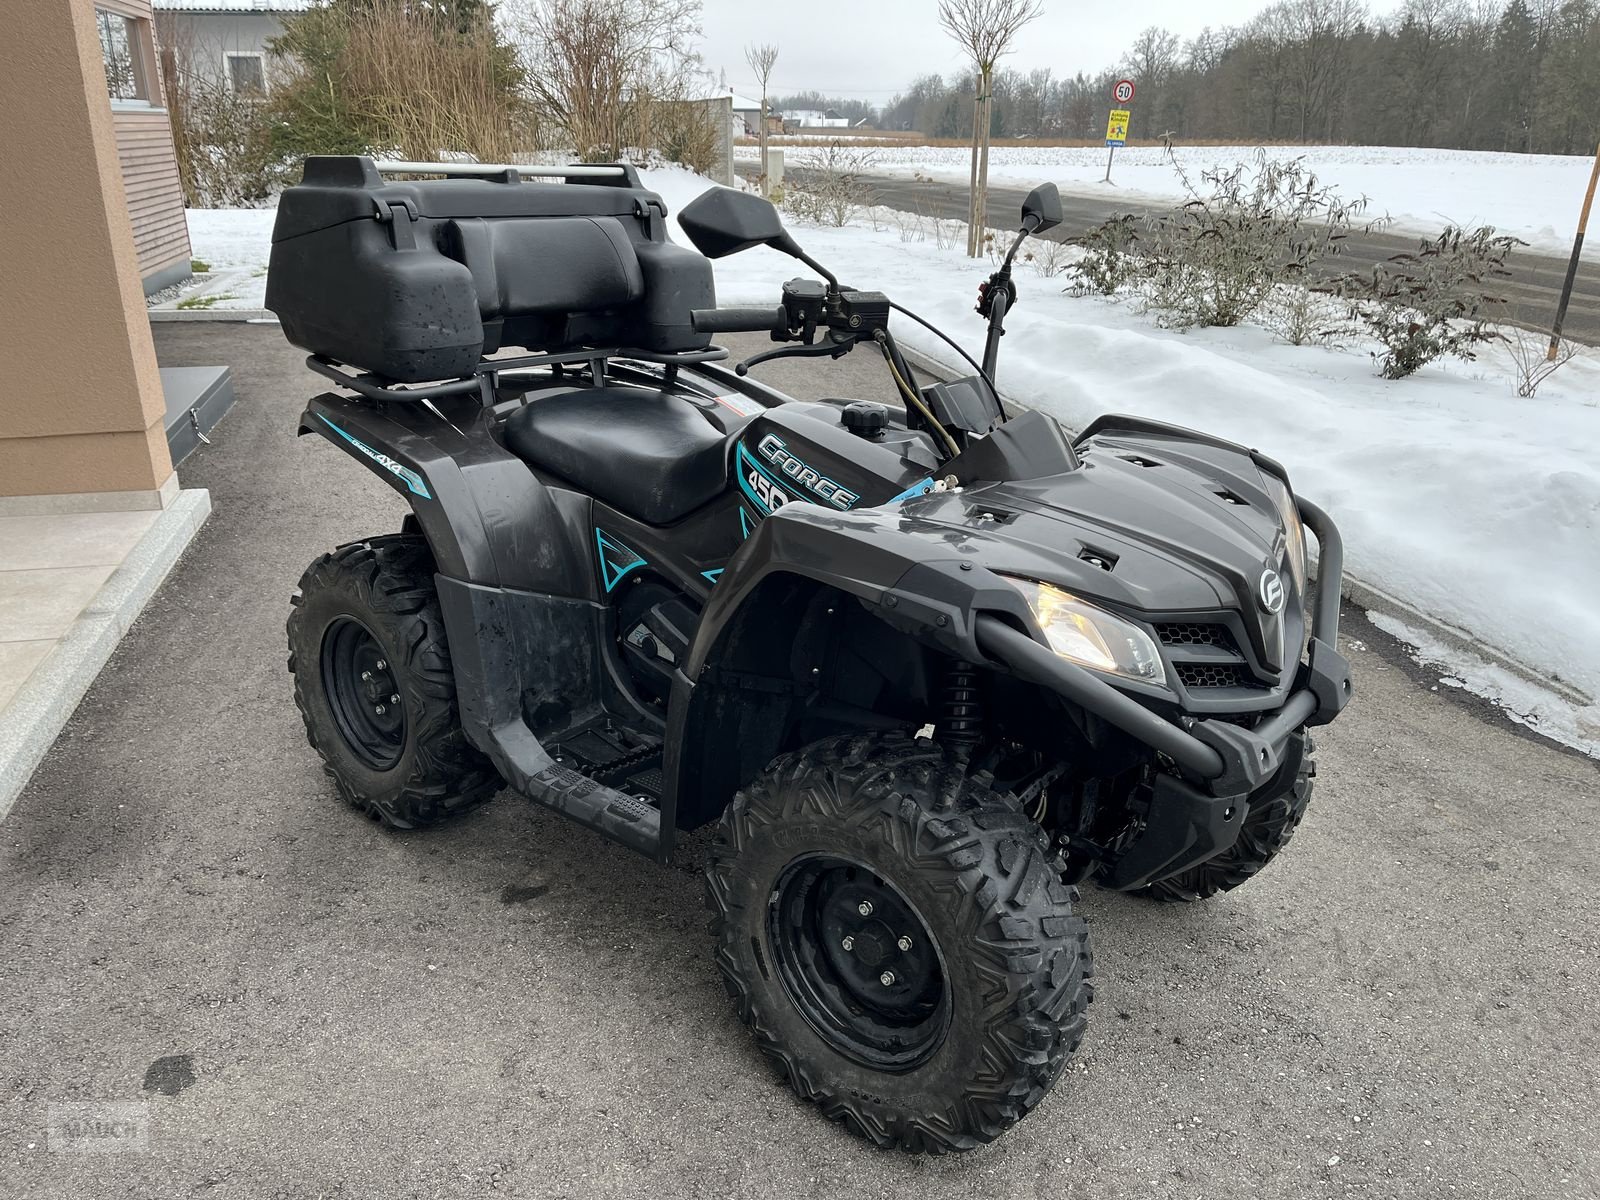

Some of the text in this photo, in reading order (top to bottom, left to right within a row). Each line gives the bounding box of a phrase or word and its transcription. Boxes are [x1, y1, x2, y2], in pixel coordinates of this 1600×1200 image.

[1118, 86, 1131, 98] 50
[748, 469, 790, 513] 450
[758, 433, 860, 512] CFORCE
